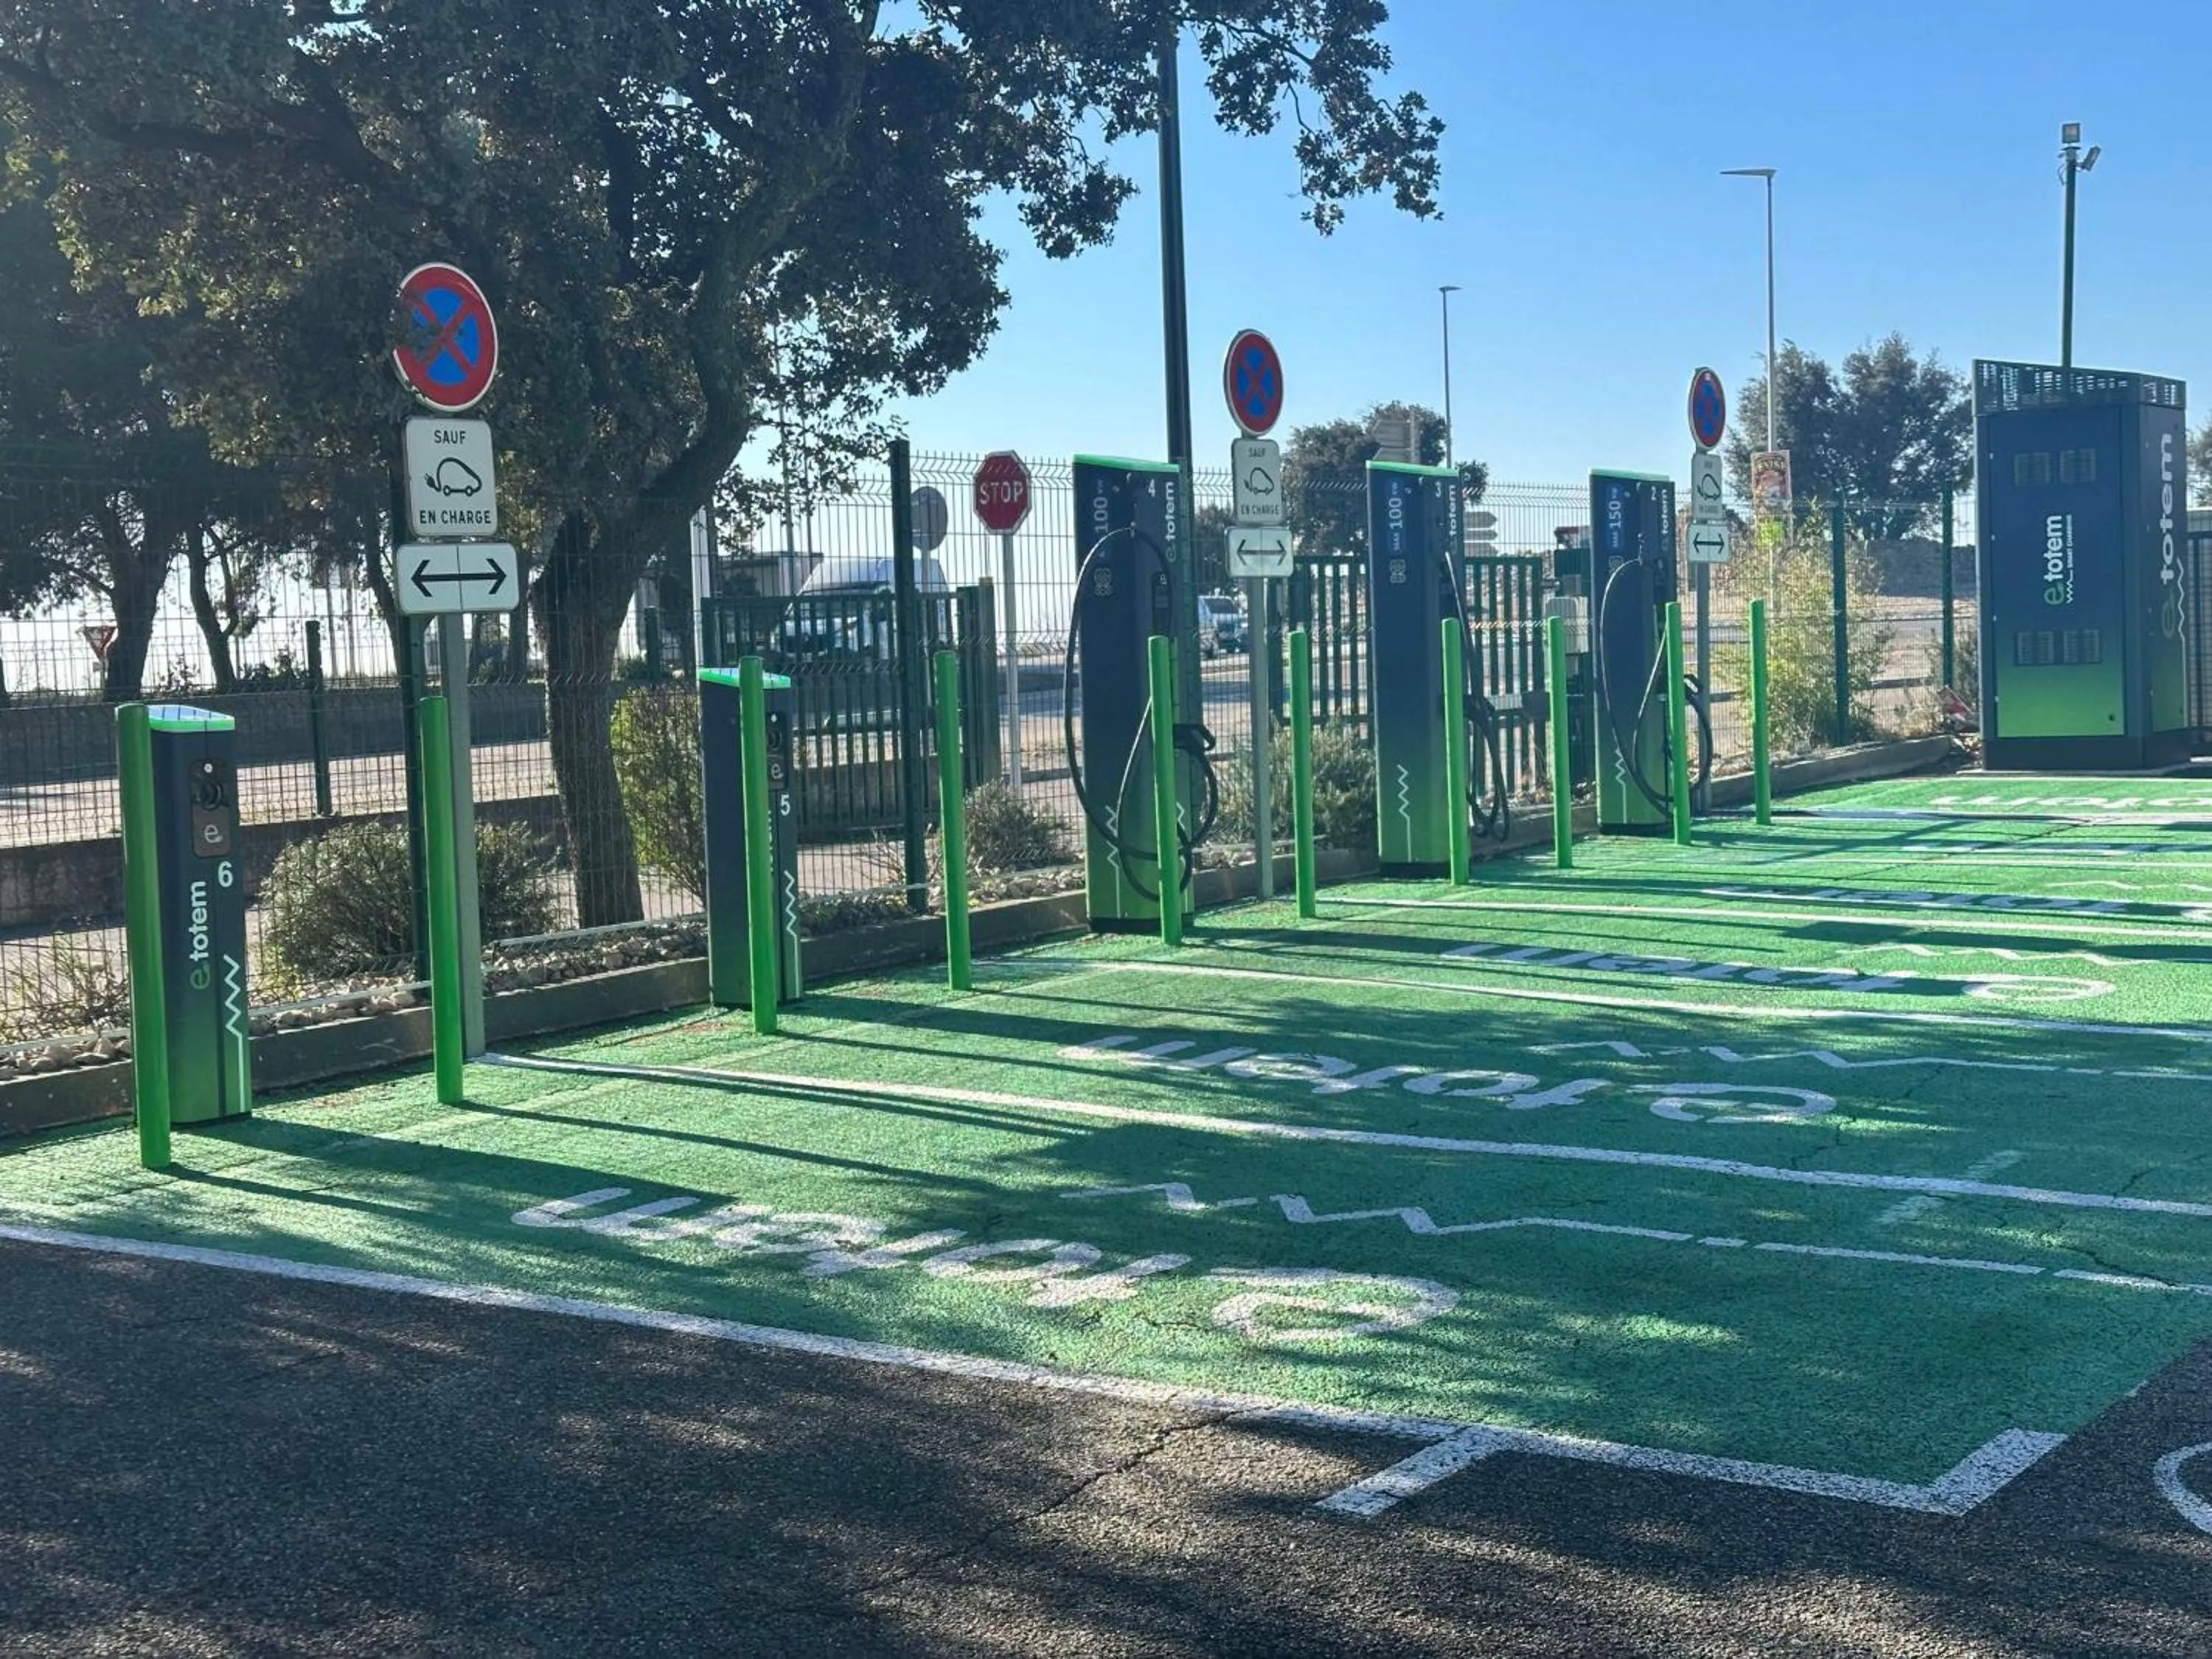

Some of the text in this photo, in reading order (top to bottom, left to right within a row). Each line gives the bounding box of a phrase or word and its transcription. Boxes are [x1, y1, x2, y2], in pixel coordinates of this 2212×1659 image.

[434, 430, 467, 444] SAUF
[979, 481, 1023, 504] STOP
[1147, 479, 1156, 498] 4
[1435, 481, 1442, 498] 3
[1651, 486, 1658, 501] 2
[420, 510, 492, 524] EN CHARGE
[1093, 496, 1108, 533] 100
[1388, 498, 1403, 530] 100
[1609, 501, 1621, 529] 150
[781, 794, 790, 816] 5
[218, 860, 233, 888] 6
